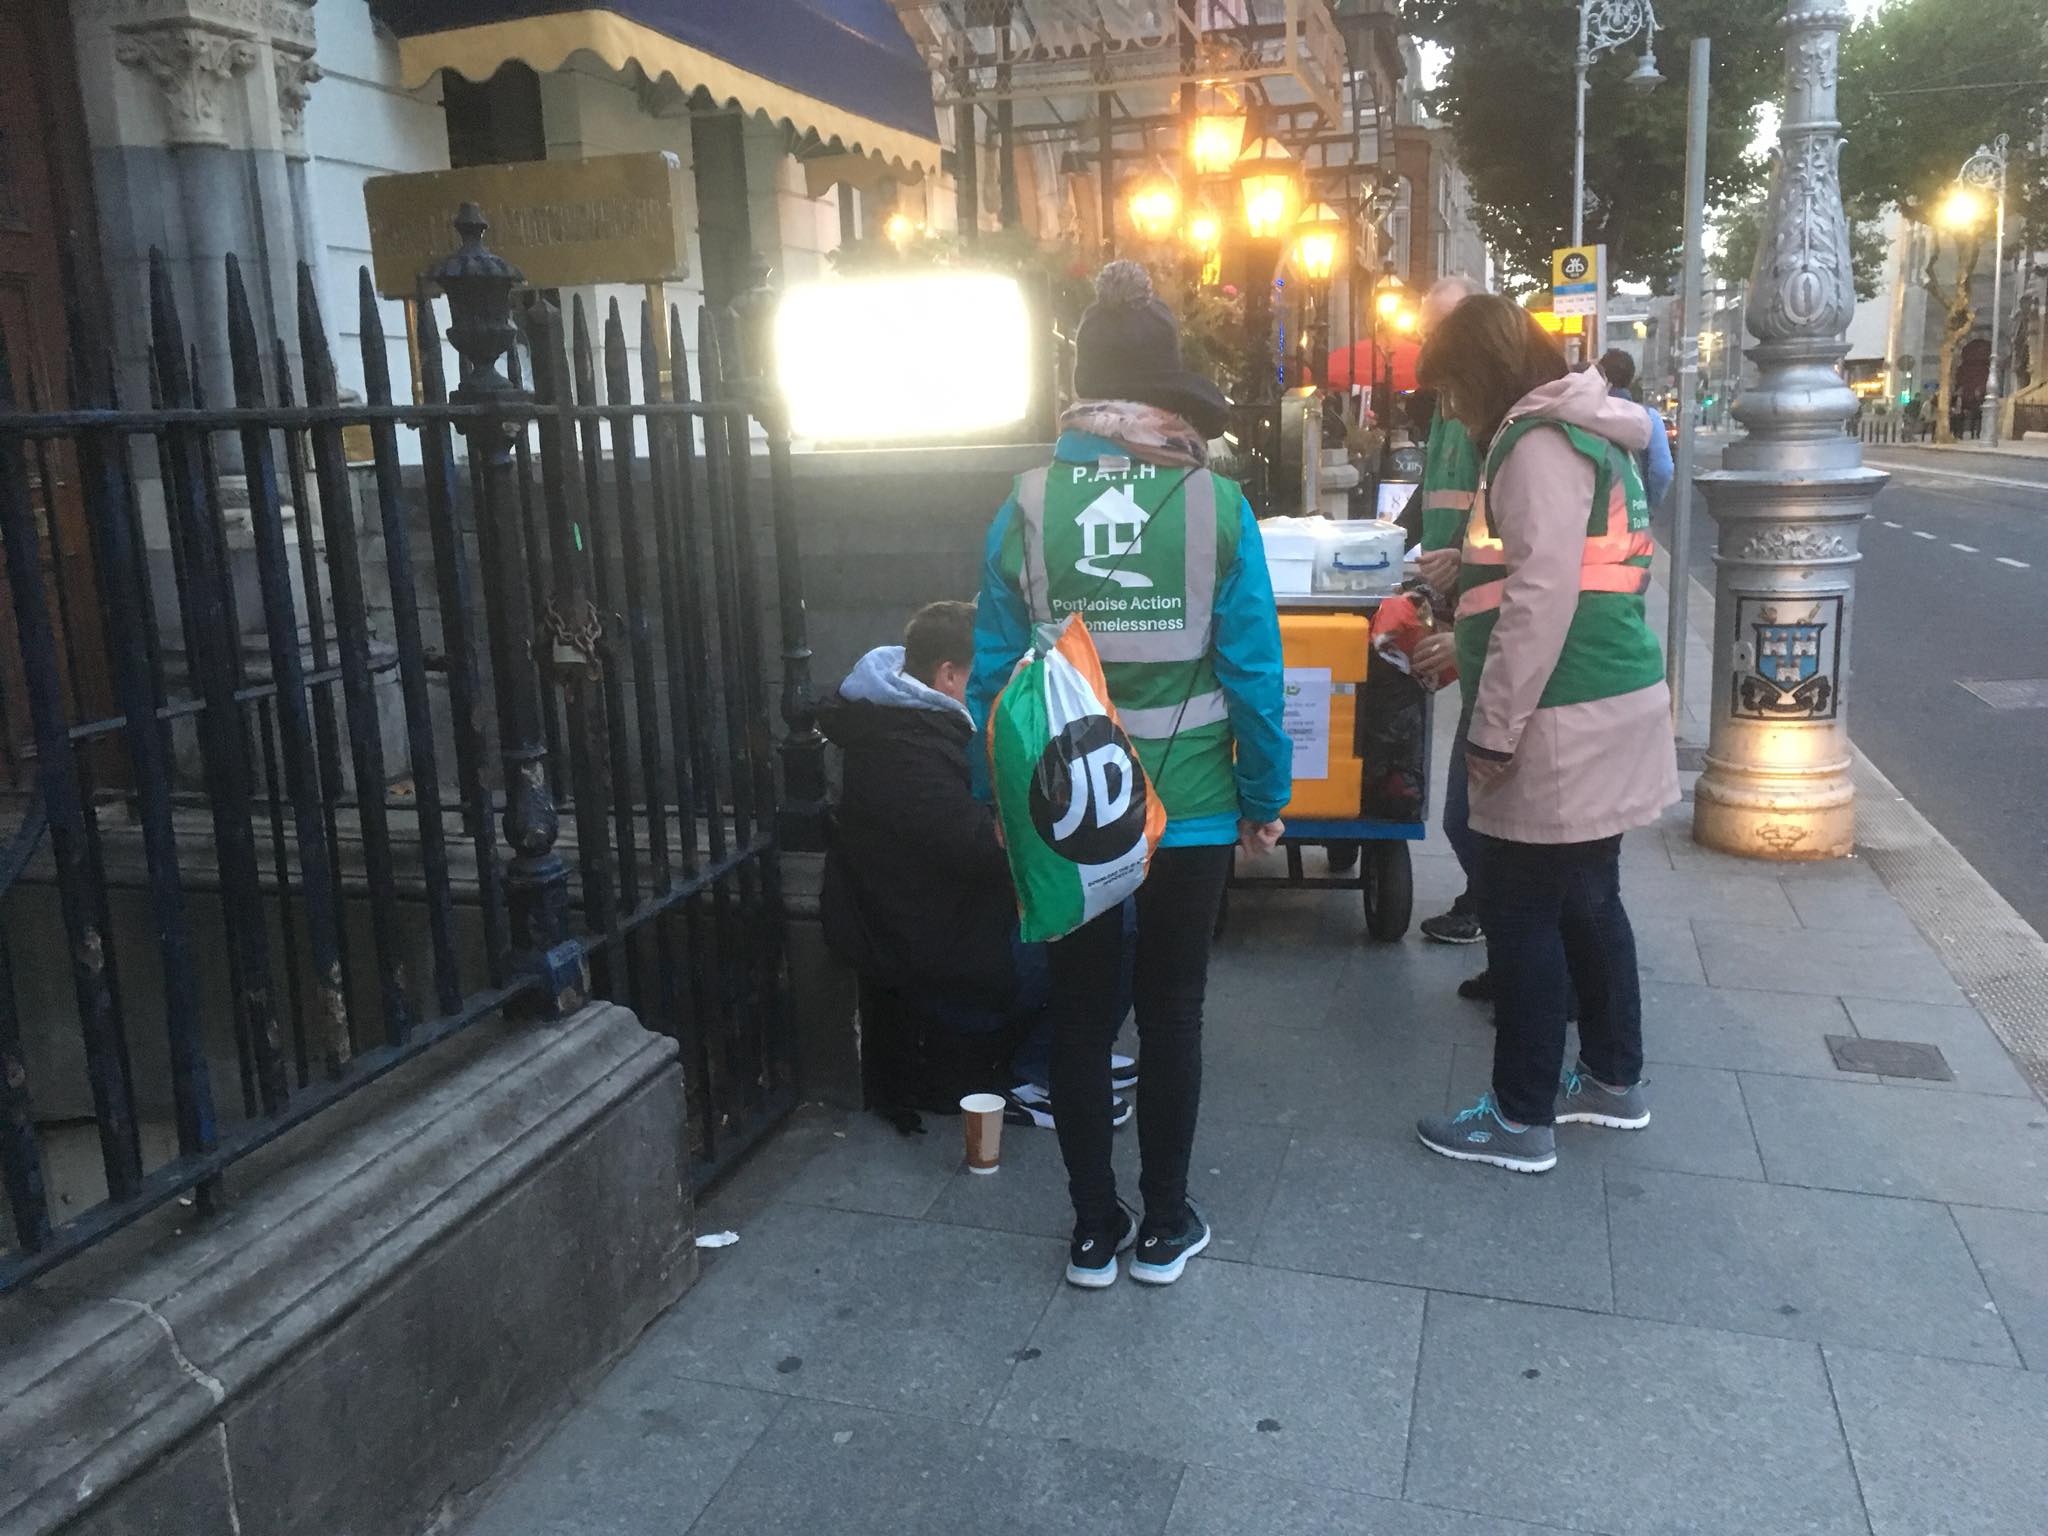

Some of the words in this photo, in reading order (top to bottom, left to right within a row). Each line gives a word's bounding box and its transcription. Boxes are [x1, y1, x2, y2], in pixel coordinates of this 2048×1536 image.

[1130, 595, 1182, 610] Action
[1085, 617, 1184, 632] omelessness
[1052, 742, 1134, 842] JD
